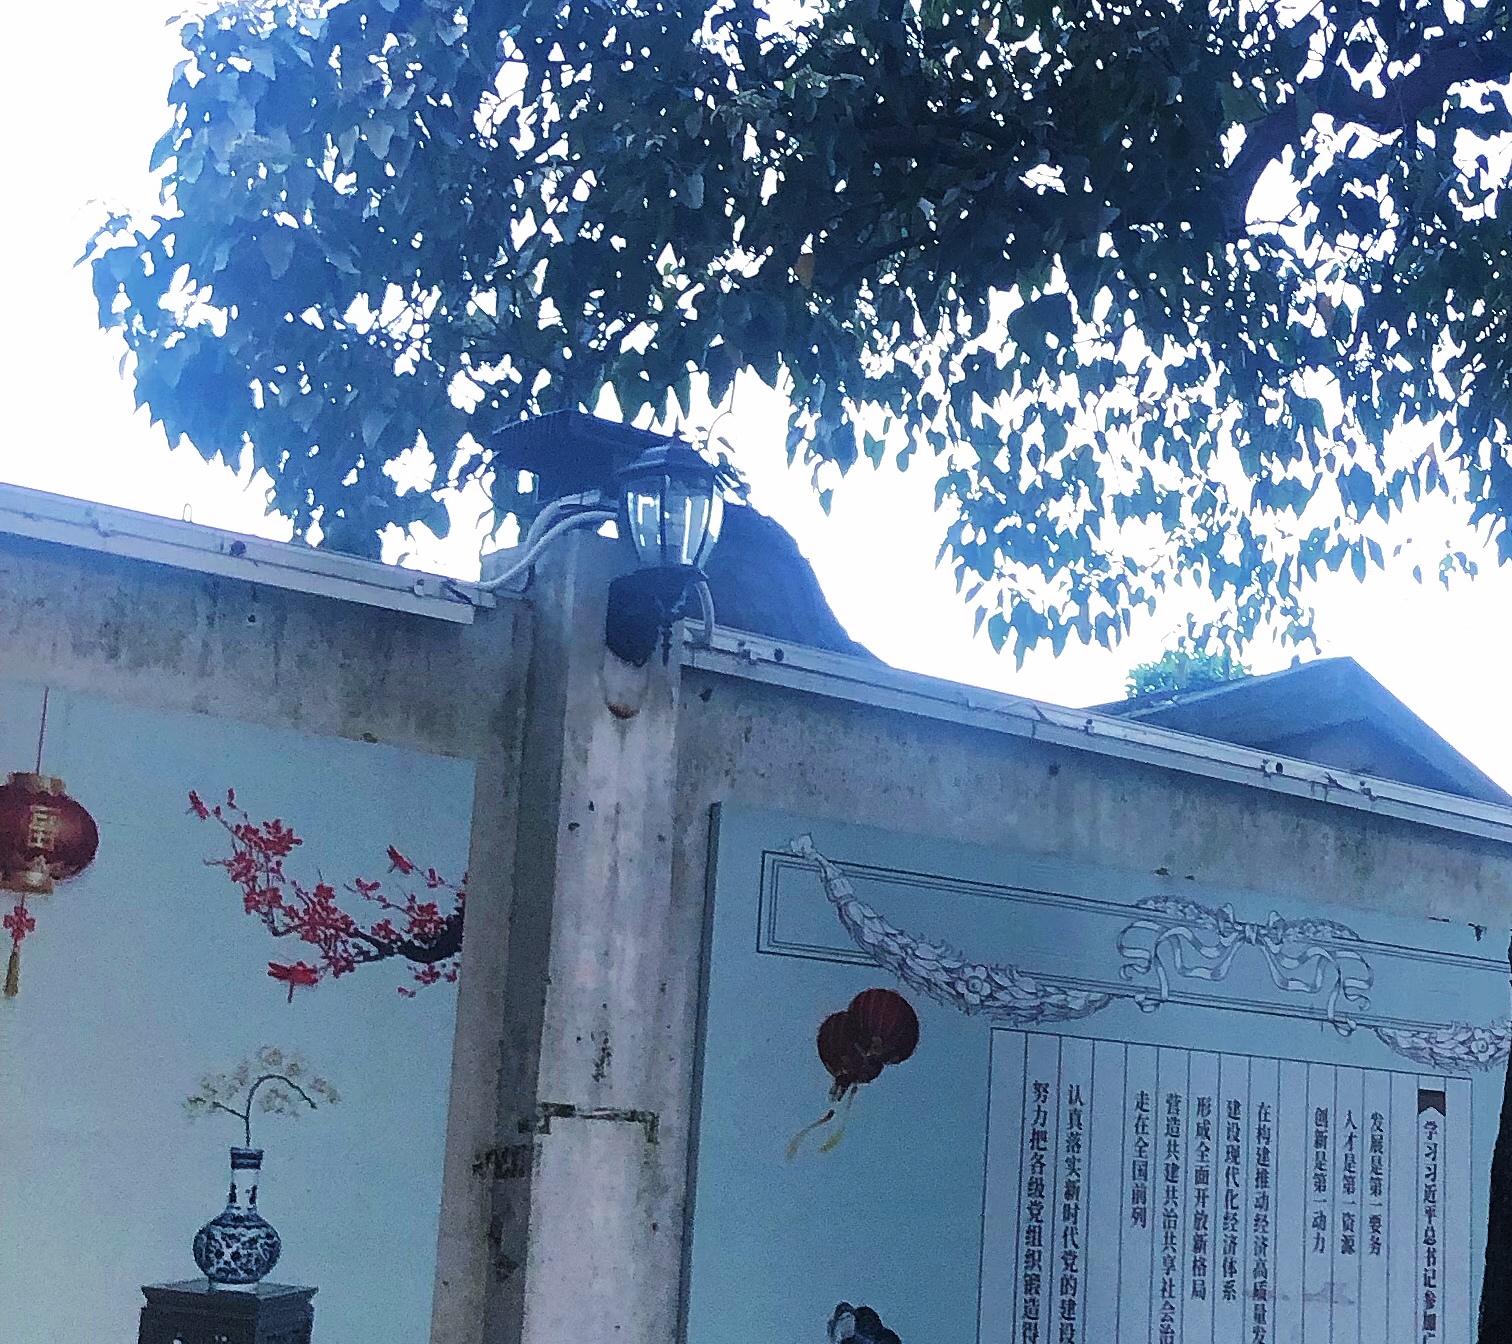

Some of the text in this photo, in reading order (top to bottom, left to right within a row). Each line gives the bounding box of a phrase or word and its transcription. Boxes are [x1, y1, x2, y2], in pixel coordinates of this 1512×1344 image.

[1130, 1090, 1151, 1229] 走在全国前列
[1190, 1095, 1212, 1301] 形成全面开放新格局
[1221, 1099, 1242, 1301] 建设现代化经济体系
[1311, 1106, 1329, 1255] 创新是第一动力
[1340, 1109, 1358, 1256] 人才是第一资源
[1368, 1111, 1385, 1256] 发展是第一要务
